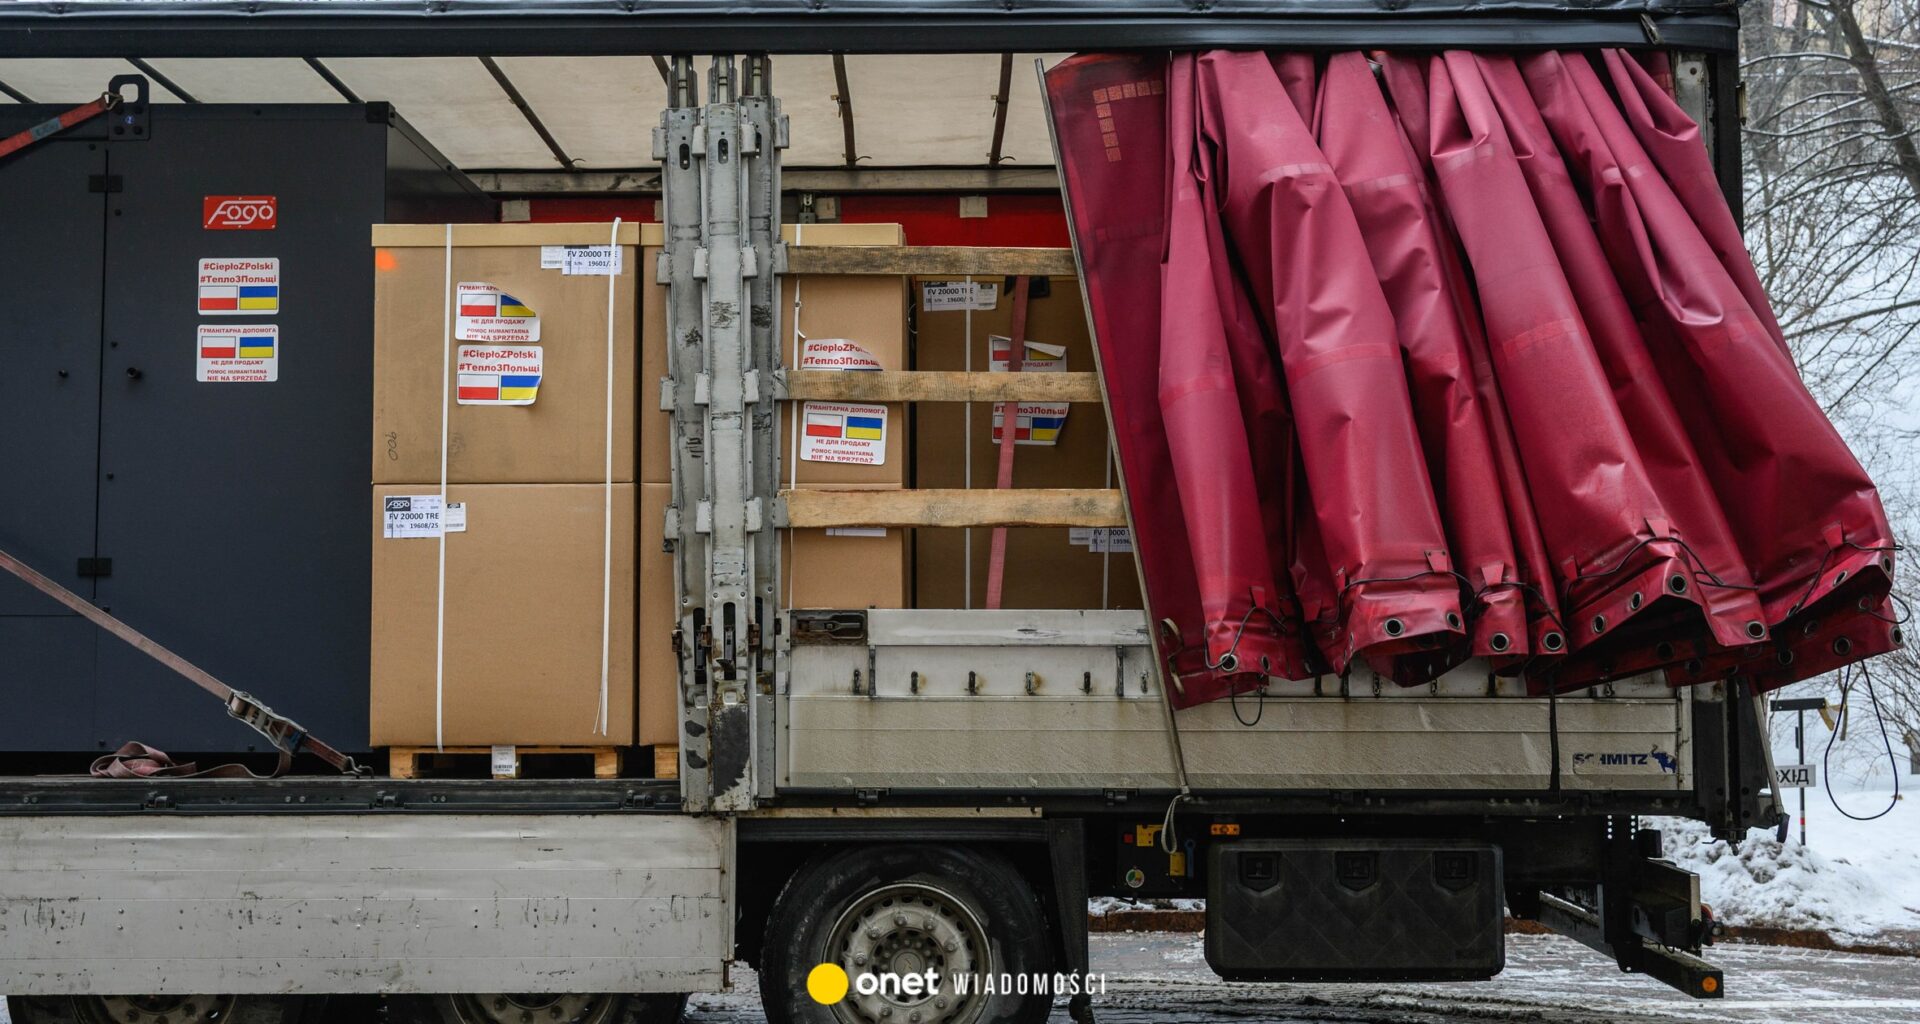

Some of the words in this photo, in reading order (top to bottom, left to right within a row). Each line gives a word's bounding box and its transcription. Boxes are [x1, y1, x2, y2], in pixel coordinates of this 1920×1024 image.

[204, 262, 273, 272] #CiepłoZPolski
[808, 344, 868, 354] #CiepłoZPo
[463, 350, 536, 359] #CiepłoZPolski
